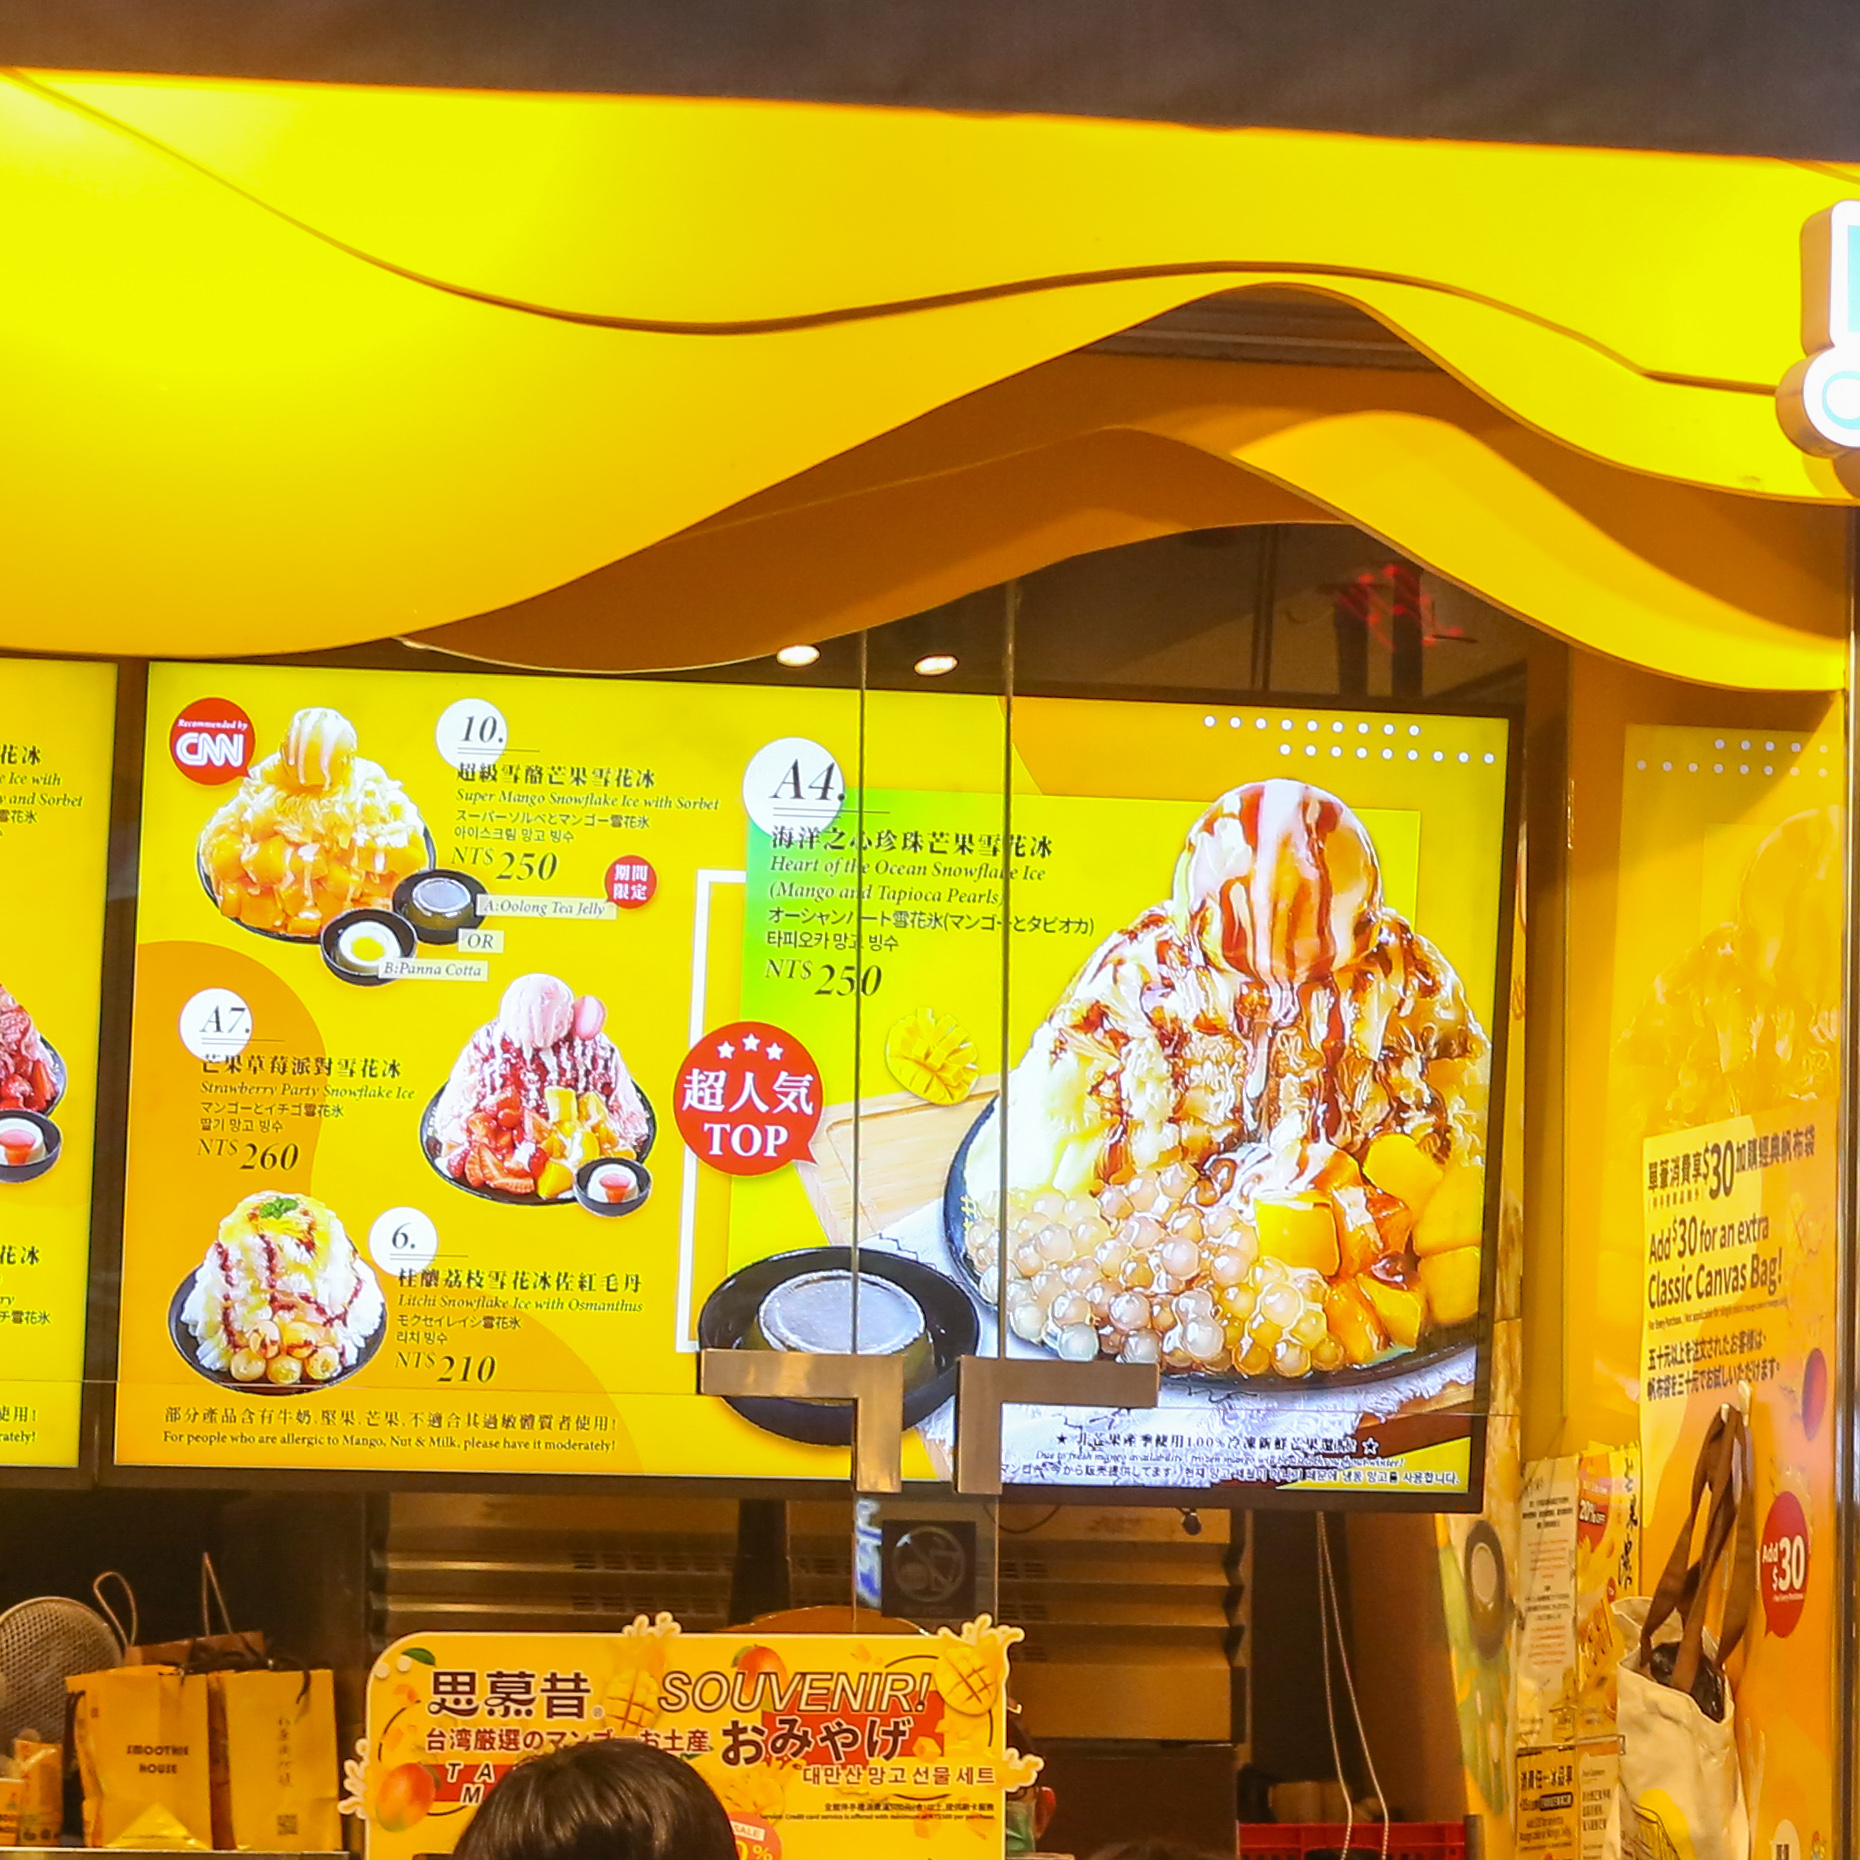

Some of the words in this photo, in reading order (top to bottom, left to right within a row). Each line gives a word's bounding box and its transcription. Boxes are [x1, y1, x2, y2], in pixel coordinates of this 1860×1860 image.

[460, 714, 504, 744] 10.
[175, 733, 243, 767] CNN
[8, 772, 28, 787] Ice
[31, 772, 61, 787] with
[768, 757, 845, 801] A4.
[10, 792, 36, 806] and
[38, 792, 83, 808] Sorbet
[455, 789, 494, 805] Super
[498, 790, 545, 807] Mango
[548, 792, 618, 809] Snowflake
[621, 794, 640, 808] Ice
[642, 795, 671, 809] with
[675, 797, 719, 811] Sorbet
[454, 825, 516, 842] 아이스크림
[521, 828, 546, 843] 망고
[549, 829, 575, 844] 빙수
[450, 845, 495, 867] NT$
[494, 850, 559, 882] 250
[613, 863, 649, 883] 期間
[769, 855, 819, 873] Heart
[823, 856, 843, 876] of
[874, 858, 927, 877] Ocean
[1021, 865, 1046, 881] Ice
[612, 882, 648, 901] 限定
[876, 884, 942, 906] Tapioca
[551, 901, 573, 915] Tea
[575, 902, 606, 919] Jelly
[466, 932, 495, 949] OR
[766, 930, 829, 950] 타피오카
[868, 934, 899, 953] 빙수
[444, 962, 482, 978] Cotta
[764, 957, 813, 980] NT$
[814, 962, 883, 998] 250
[198, 1004, 251, 1034] A7.
[200, 1080, 278, 1098] Strawberry
[280, 1082, 320, 1099] Party
[322, 1083, 393, 1101] Snowflake
[395, 1086, 416, 1100] Ice
[683, 1067, 815, 1117] 超人気
[702, 1124, 790, 1159] TOP
[239, 1142, 300, 1171] 260
[1648, 1226, 1672, 1265] Add
[1672, 1214, 1698, 1259] $30
[1699, 1219, 1717, 1254] for
[1719, 1224, 1735, 1249] an
[1737, 1214, 1770, 1245] extra
[1648, 1263, 1693, 1311] Classic
[1695, 1260, 1747, 1300] Canvas
[1750, 1246, 1784, 1297] Bag!
[397, 1293, 437, 1308] Litchi
[439, 1294, 509, 1311] Snowflake
[512, 1296, 532, 1310] Ice
[534, 1297, 564, 1311] with
[567, 1298, 644, 1313] Osmanthus
[437, 1354, 497, 1383] 210
[163, 1430, 184, 1443] For
[186, 1432, 227, 1446] people
[230, 1431, 257, 1444] who
[258, 1435, 277, 1444] are
[279, 1432, 325, 1447] allergic
[327, 1435, 340, 1446] to
[389, 1435, 412, 1448] Nut
[463, 1438, 500, 1451] please
[503, 1438, 530, 1450] have
[532, 1438, 542, 1450] it
[544, 1440, 616, 1453] moderately!
[1762, 1541, 1779, 1565] Add
[1772, 1534, 1806, 1592] $30
[429, 1668, 592, 1721] 思慕昔
[656, 1669, 934, 1715] SOUVENIR!
[126, 1744, 190, 1757] SMOOTHIE
[720, 1716, 911, 1767] おみやげ
[138, 1763, 178, 1775] HOUSE
[801, 1765, 865, 1786] 대만산
[866, 1765, 908, 1787] 망고
[911, 1766, 952, 1787] 선물
[955, 1767, 996, 1787] 세트
[733, 1824, 762, 1838] SALE
